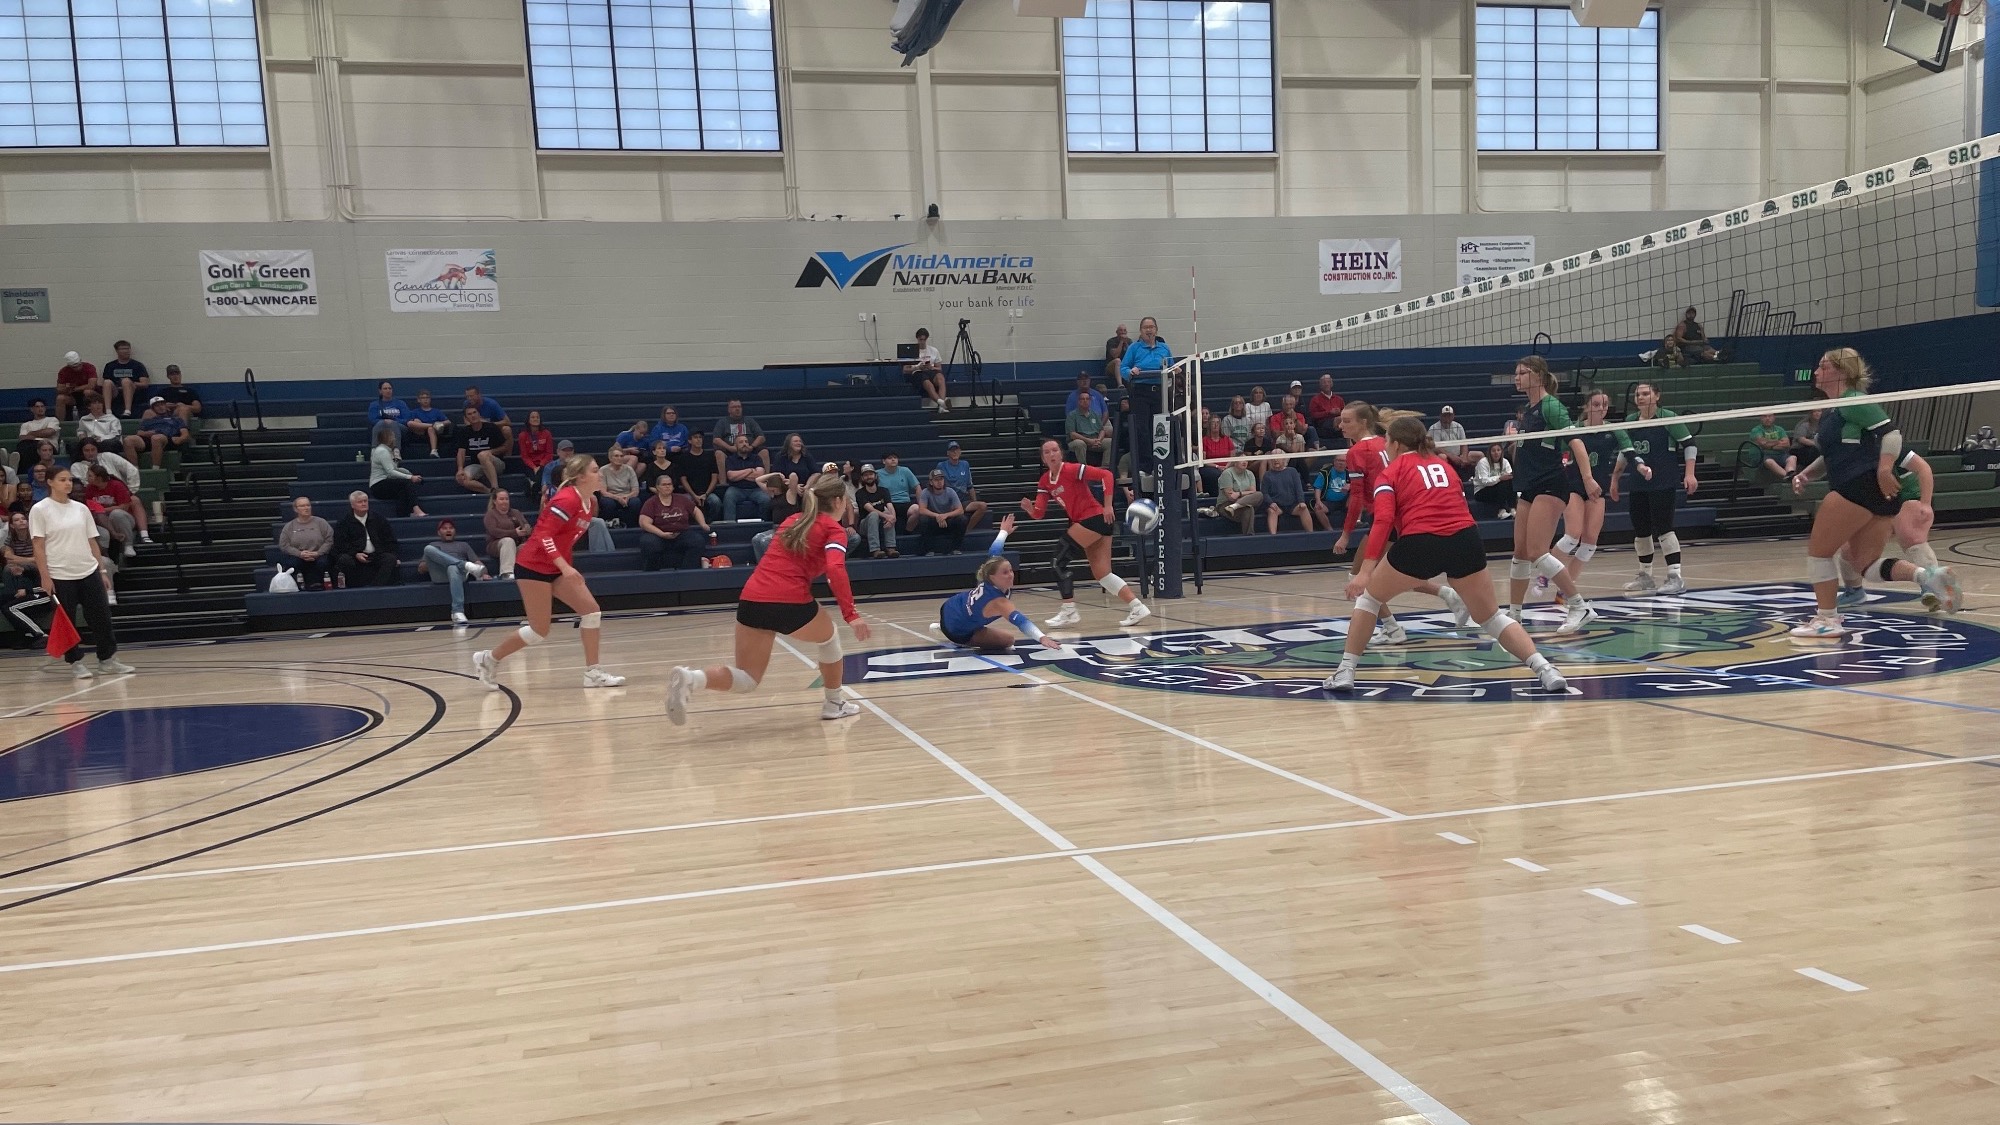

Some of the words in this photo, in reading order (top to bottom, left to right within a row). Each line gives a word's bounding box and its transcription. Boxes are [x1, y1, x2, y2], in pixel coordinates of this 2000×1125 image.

[1948, 143, 1981, 166] SRC
[1865, 168, 1895, 189] SRC
[1792, 190, 1818, 209] SRC
[1725, 209, 1749, 227] SRC
[1665, 227, 1687, 243] SRC
[1611, 242, 1631, 258] SRC
[893, 254, 1034, 269] MidAmerica
[1331, 252, 1388, 271] HEIN
[1563, 256, 1580, 271] SRC
[208, 264, 245, 279] Golf
[259, 264, 310, 279] Green
[1323, 272, 1371, 281] CONSTRUCTION
[1518, 269, 1535, 282] SRC
[260, 282, 303, 292] Landscaping
[1478, 280, 1493, 293] SRC
[205, 296, 317, 306] 1-800-LAWNCARE
[395, 289, 493, 303] Connections
[939, 299, 963, 310] your
[968, 297, 993, 308] bank
[998, 296, 1013, 307] for
[1018, 296, 1035, 307] life
[1441, 291, 1455, 303] SRC
[1417, 464, 1449, 490] 18
[1157, 463, 1165, 591] SNAPPERS
